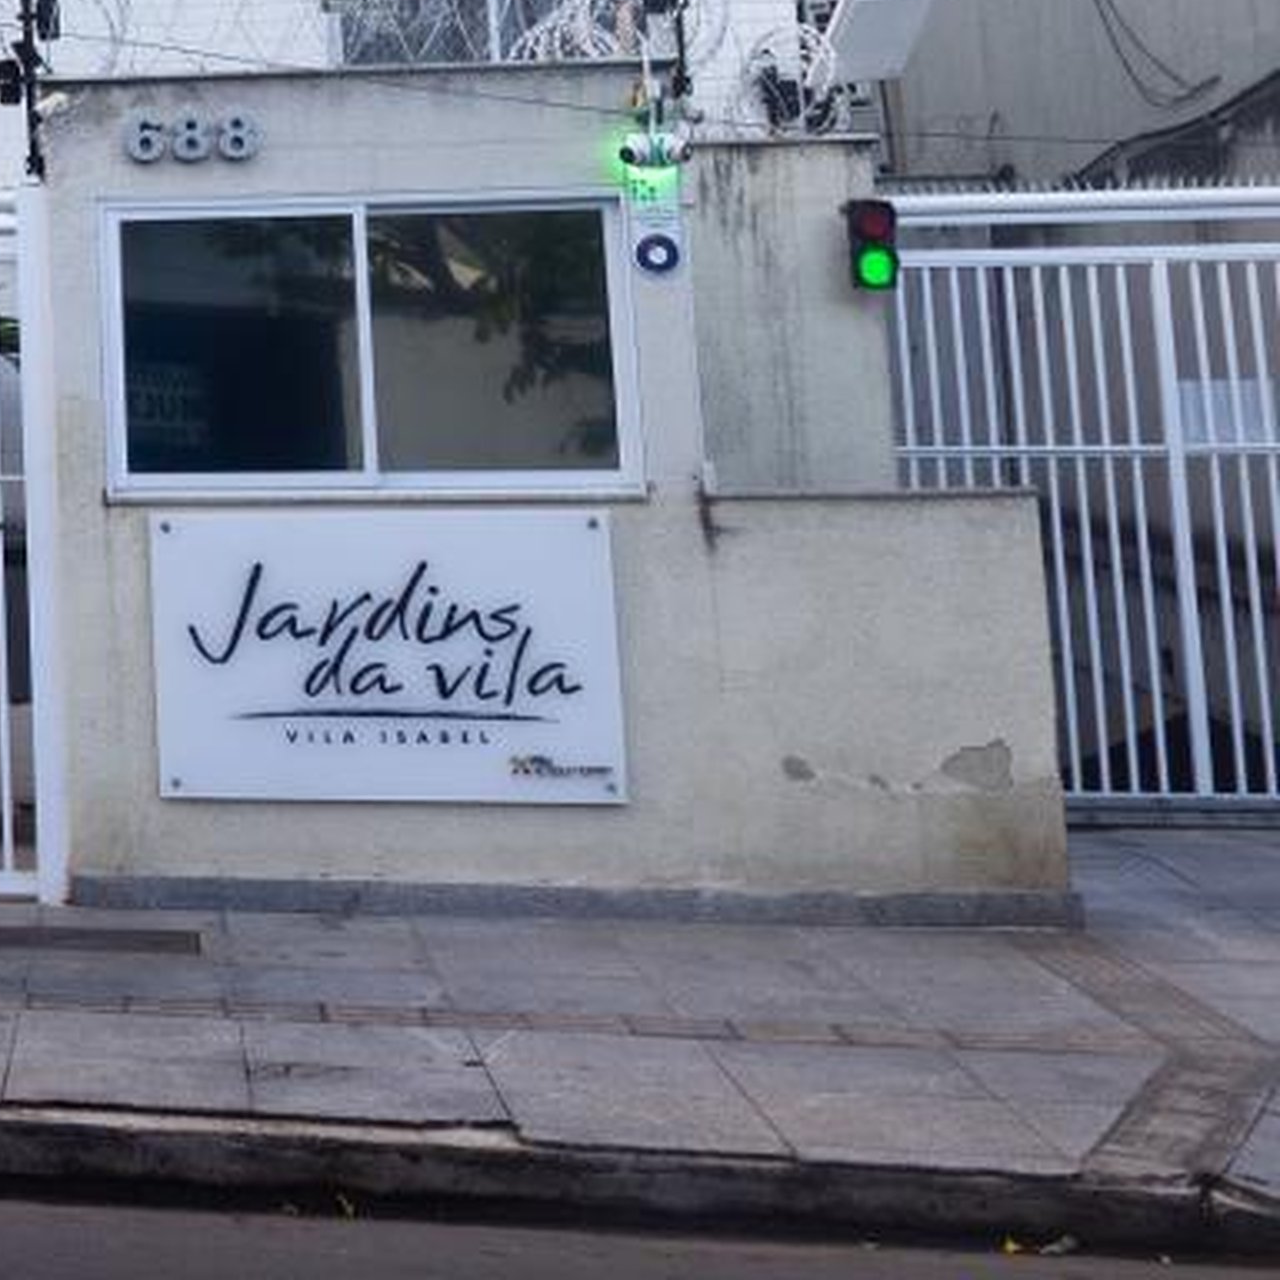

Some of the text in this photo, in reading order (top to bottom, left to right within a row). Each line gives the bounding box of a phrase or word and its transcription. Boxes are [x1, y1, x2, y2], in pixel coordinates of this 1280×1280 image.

[127, 107, 263, 163] 688
[188, 561, 522, 664] Jardins
[303, 627, 583, 706] da vila
[286, 730, 491, 745] VILA ISABEL
